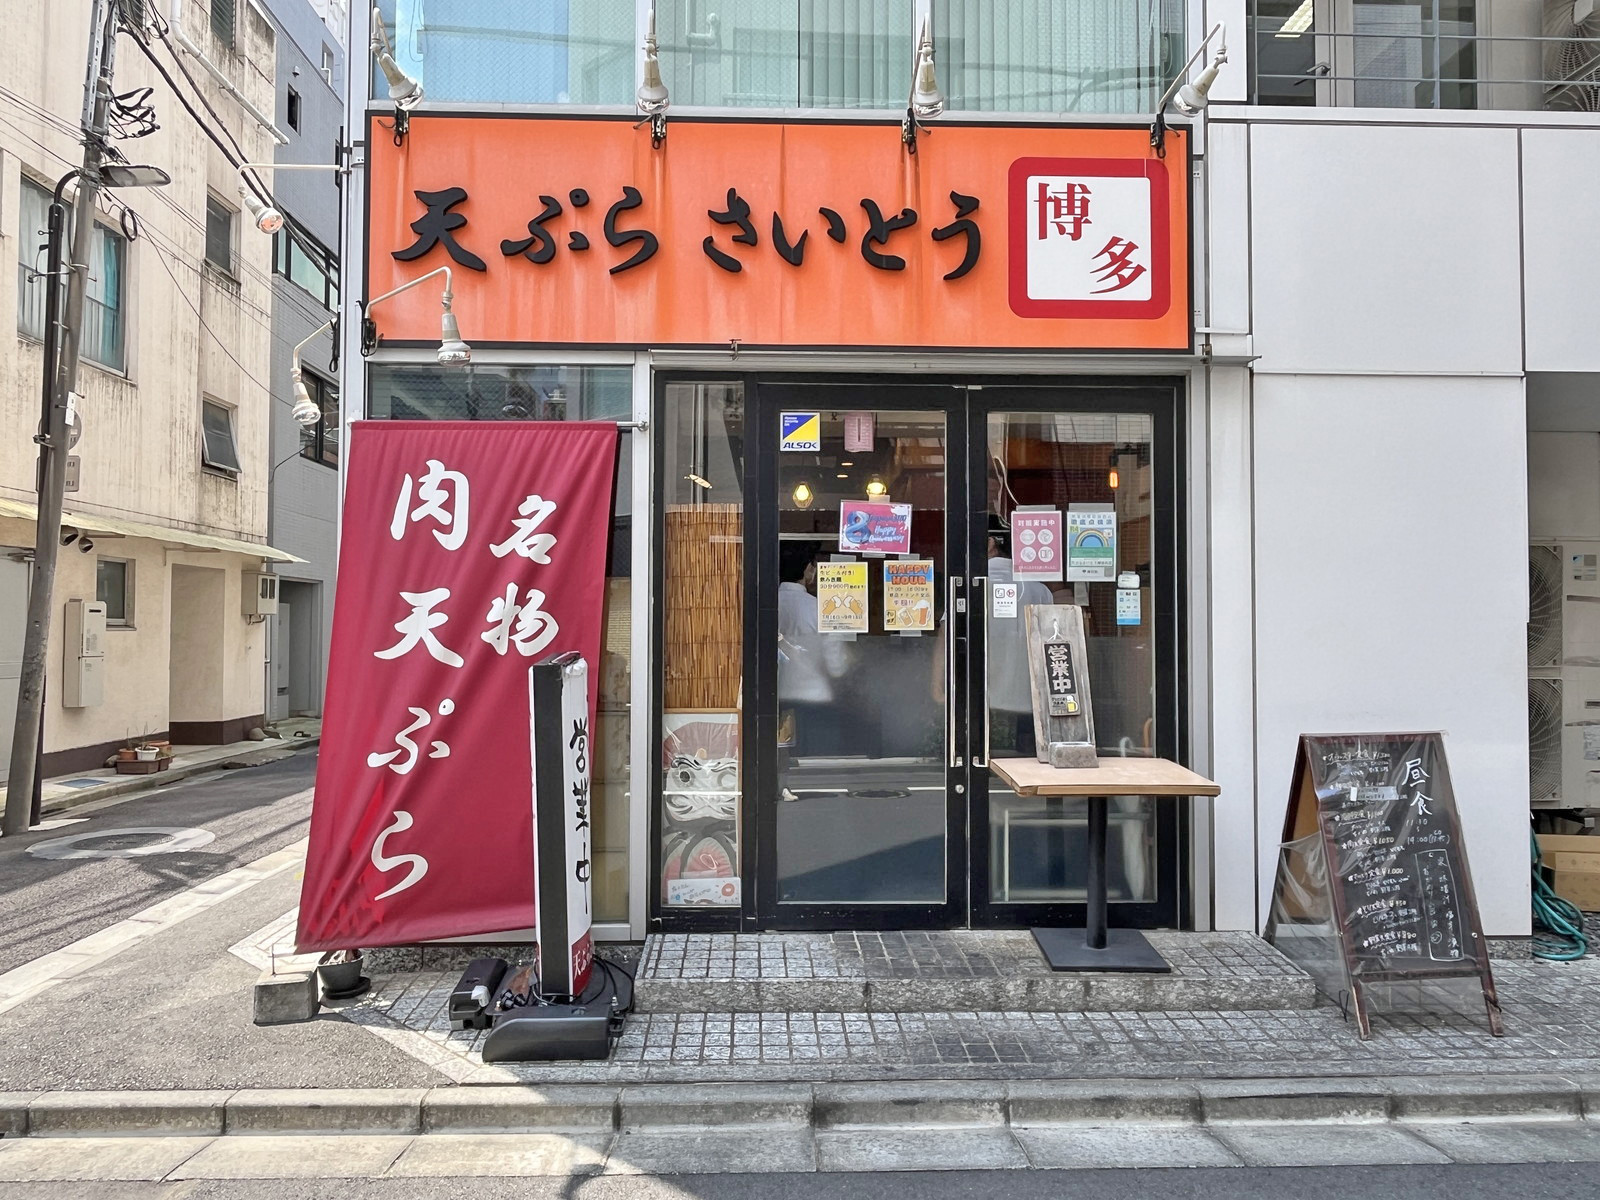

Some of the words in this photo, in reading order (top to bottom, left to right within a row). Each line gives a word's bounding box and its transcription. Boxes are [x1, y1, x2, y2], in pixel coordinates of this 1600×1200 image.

[390, 185, 659, 275] 天ぷら
[703, 185, 982, 281] さいとう
[1033, 181, 1149, 296] 博多
[782, 441, 819, 450] ALSOK
[480, 493, 561, 658] 名物
[887, 564, 931, 575] HAPPY
[891, 574, 927, 585] HOUR
[367, 458, 470, 903] 肉天ぷら
[1048, 644, 1072, 693] 営業中
[1401, 757, 1434, 816] 昼食
